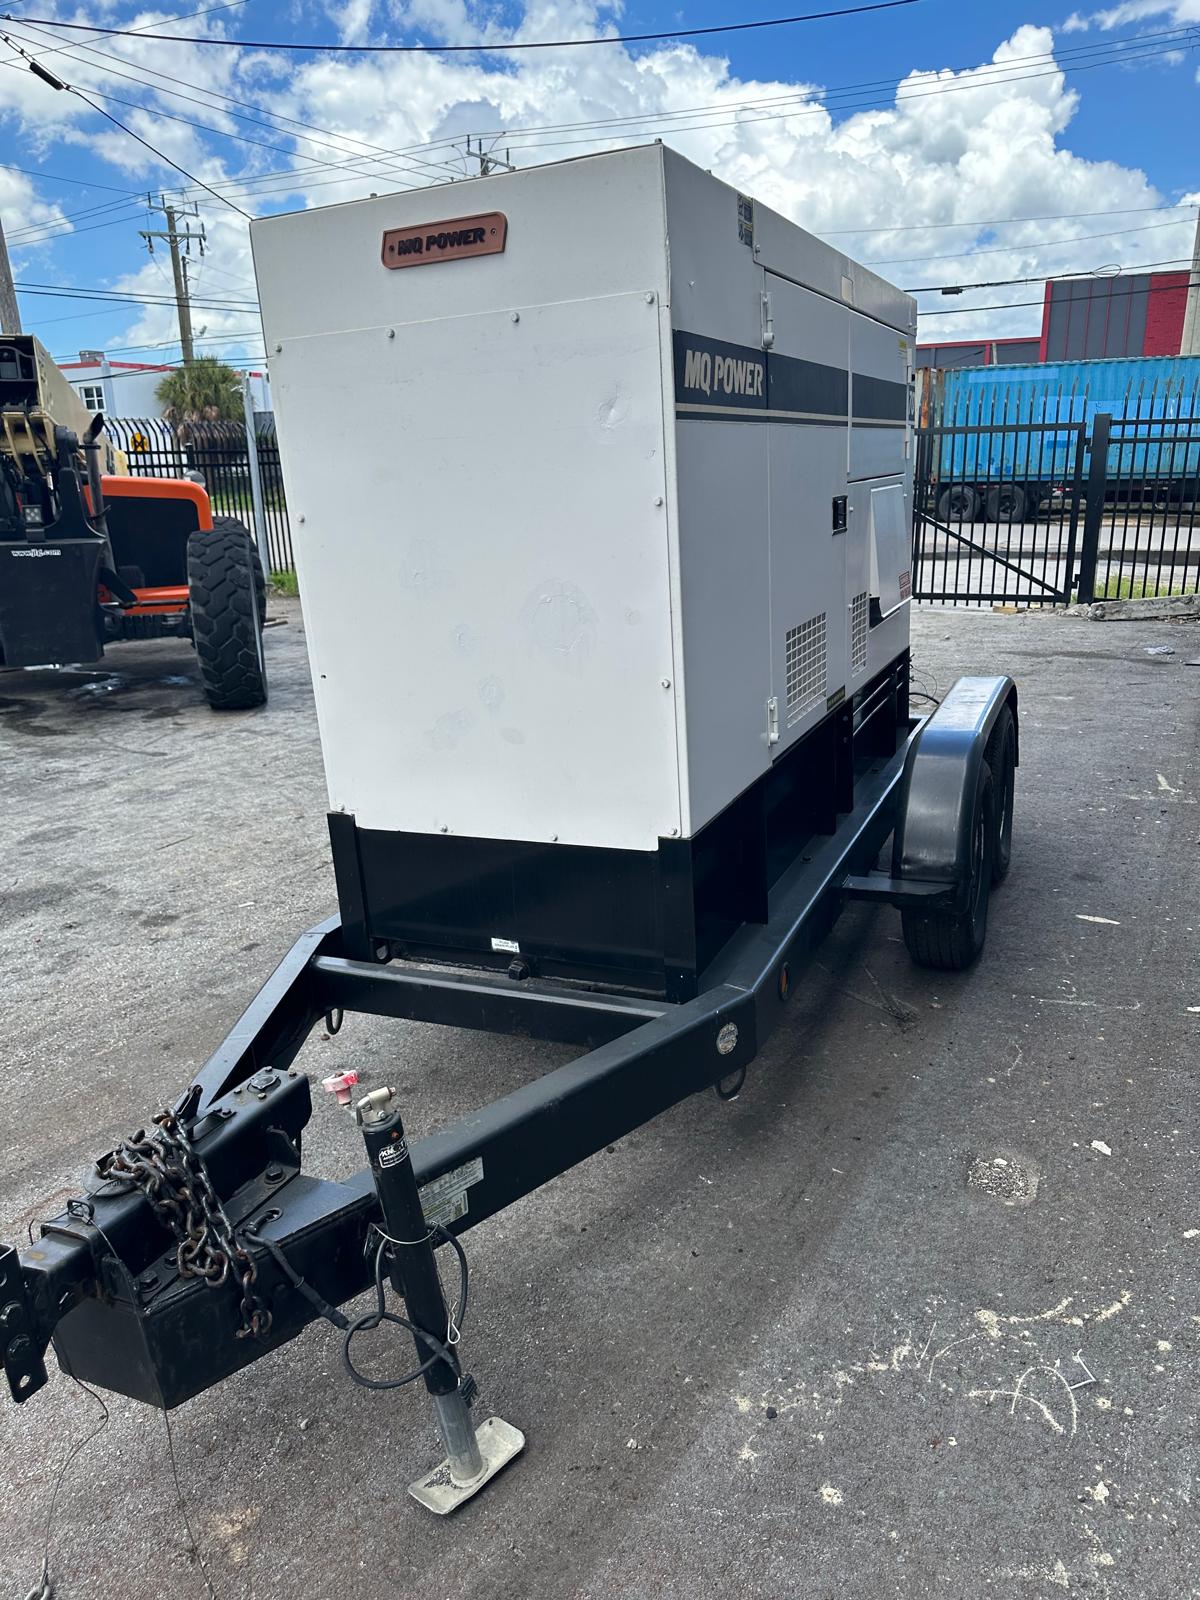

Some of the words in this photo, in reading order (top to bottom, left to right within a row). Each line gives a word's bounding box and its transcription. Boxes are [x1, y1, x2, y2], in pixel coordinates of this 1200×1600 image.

[398, 236, 424, 256] MQ
[425, 227, 486, 251] POWER
[684, 349, 712, 397] MQ
[713, 355, 764, 396] POWER
[11, 548, 62, 558] www.jlg.com
